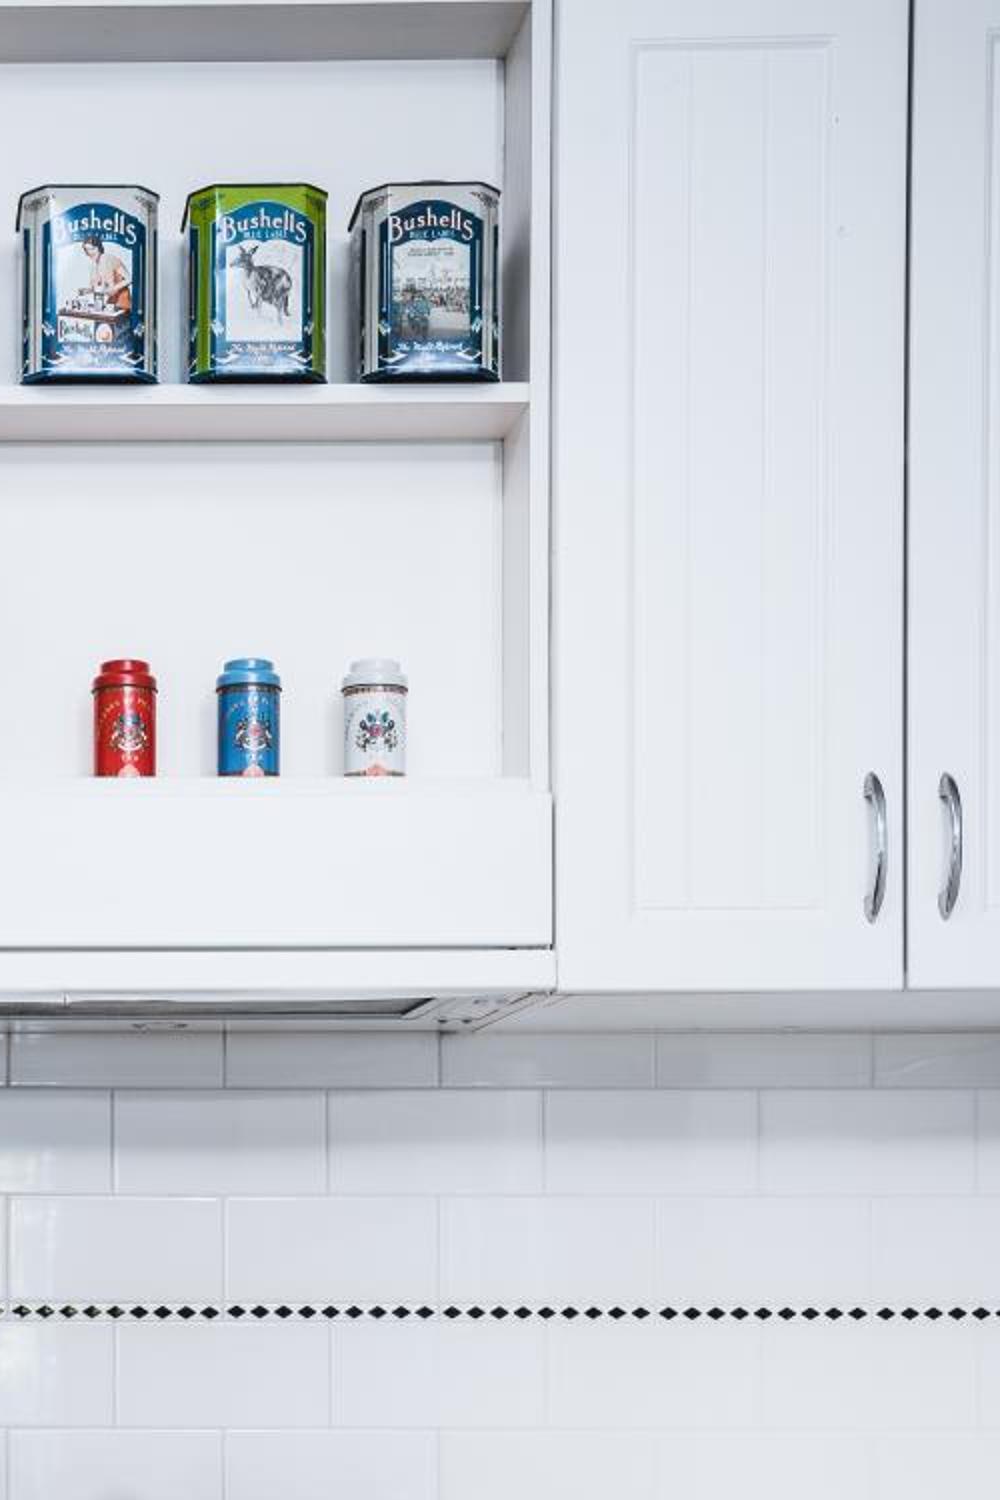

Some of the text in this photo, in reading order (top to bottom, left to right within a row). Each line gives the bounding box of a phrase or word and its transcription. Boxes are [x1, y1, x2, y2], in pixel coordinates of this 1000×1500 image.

[53, 208, 137, 245] Bushells
[217, 206, 307, 243] Bushells
[388, 206, 473, 241] Bushells
